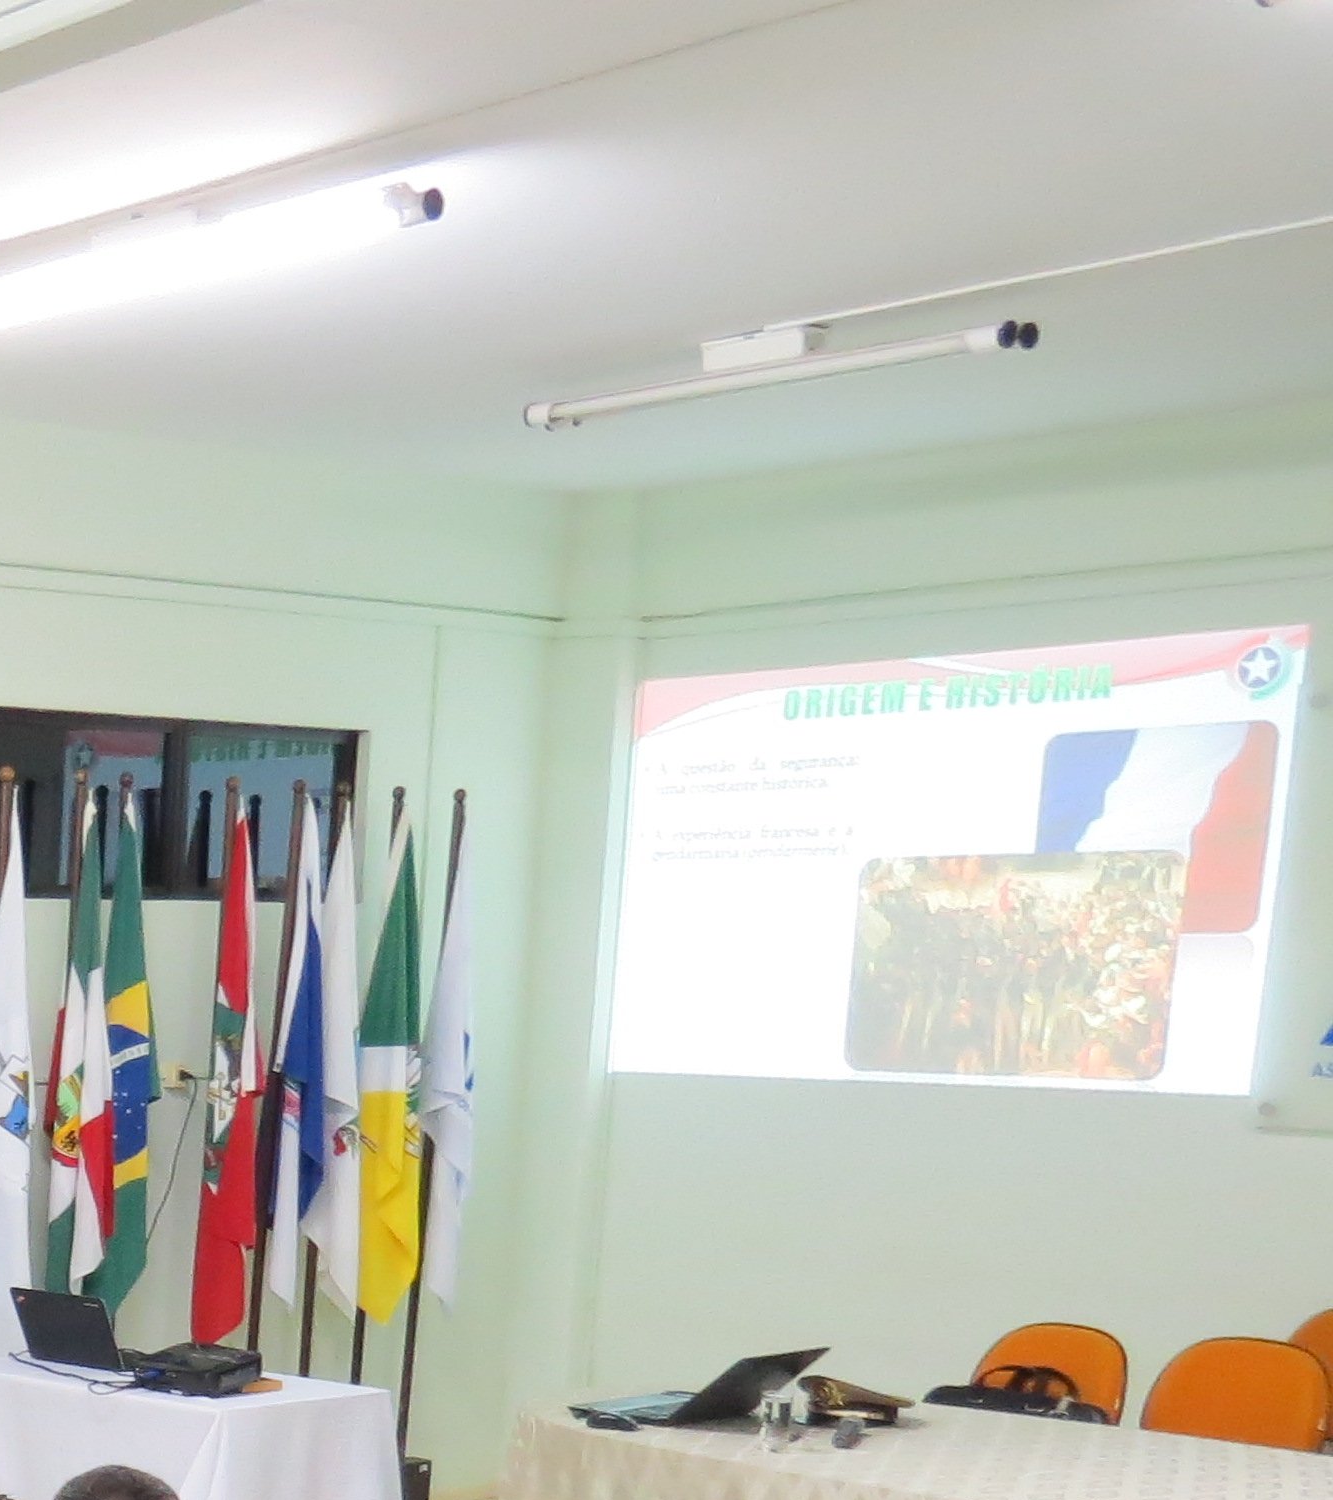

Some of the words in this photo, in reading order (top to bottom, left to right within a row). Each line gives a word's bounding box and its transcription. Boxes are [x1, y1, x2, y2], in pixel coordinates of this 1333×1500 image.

[783, 680, 908, 721] ORIGEM
[918, 678, 935, 712] E
[945, 663, 1114, 710] HISTÓRIA
